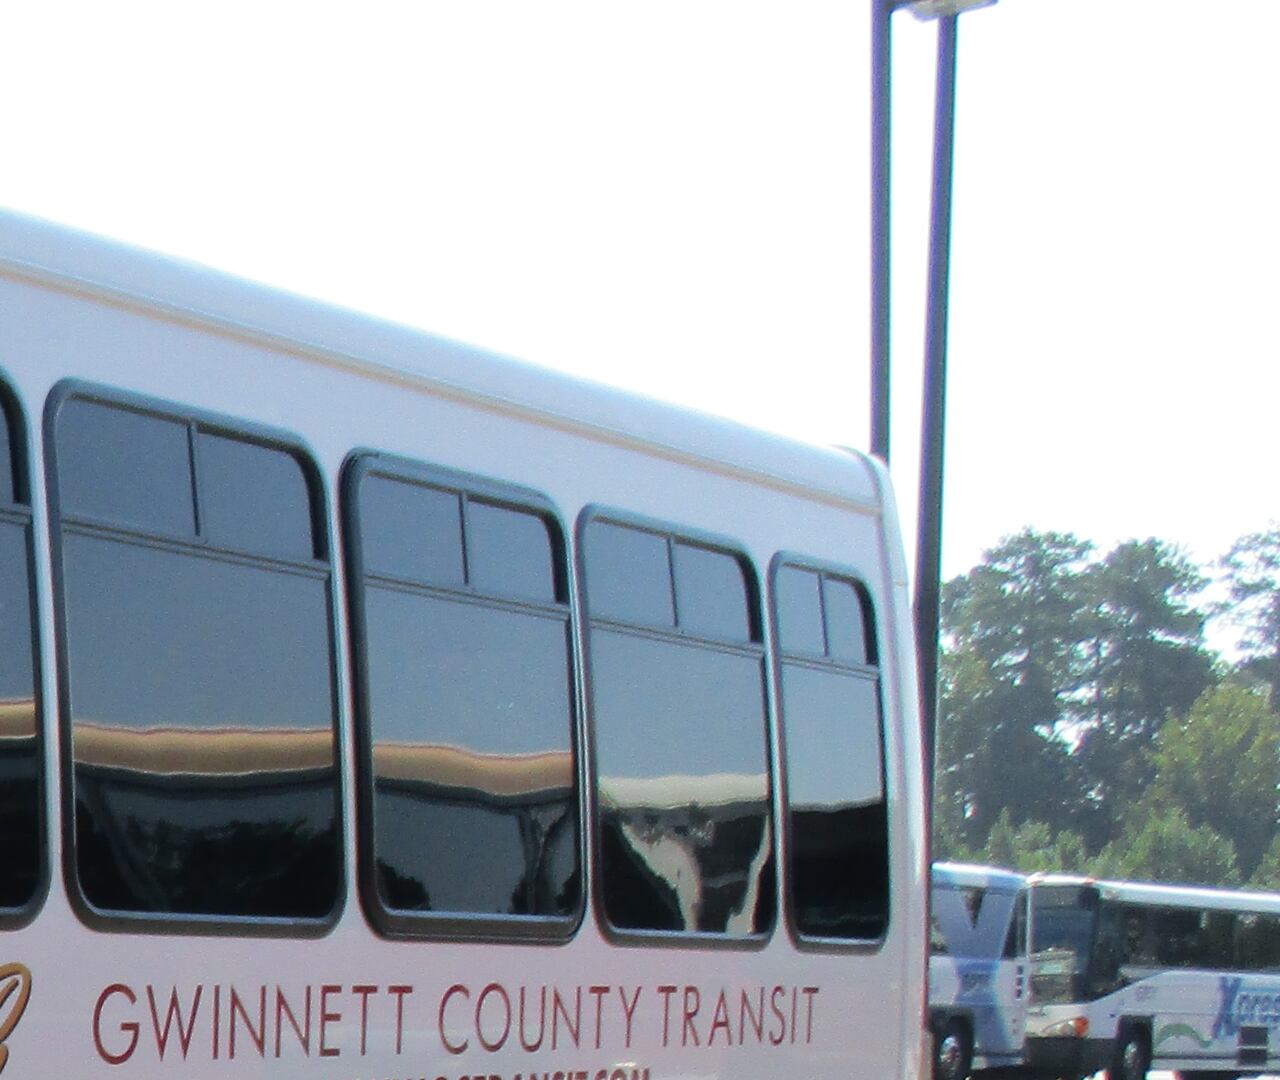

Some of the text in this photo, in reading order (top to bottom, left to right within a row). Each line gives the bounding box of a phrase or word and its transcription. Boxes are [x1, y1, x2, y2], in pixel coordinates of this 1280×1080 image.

[92, 982, 820, 1065] GWINNETT COUNTY TRANSIT
